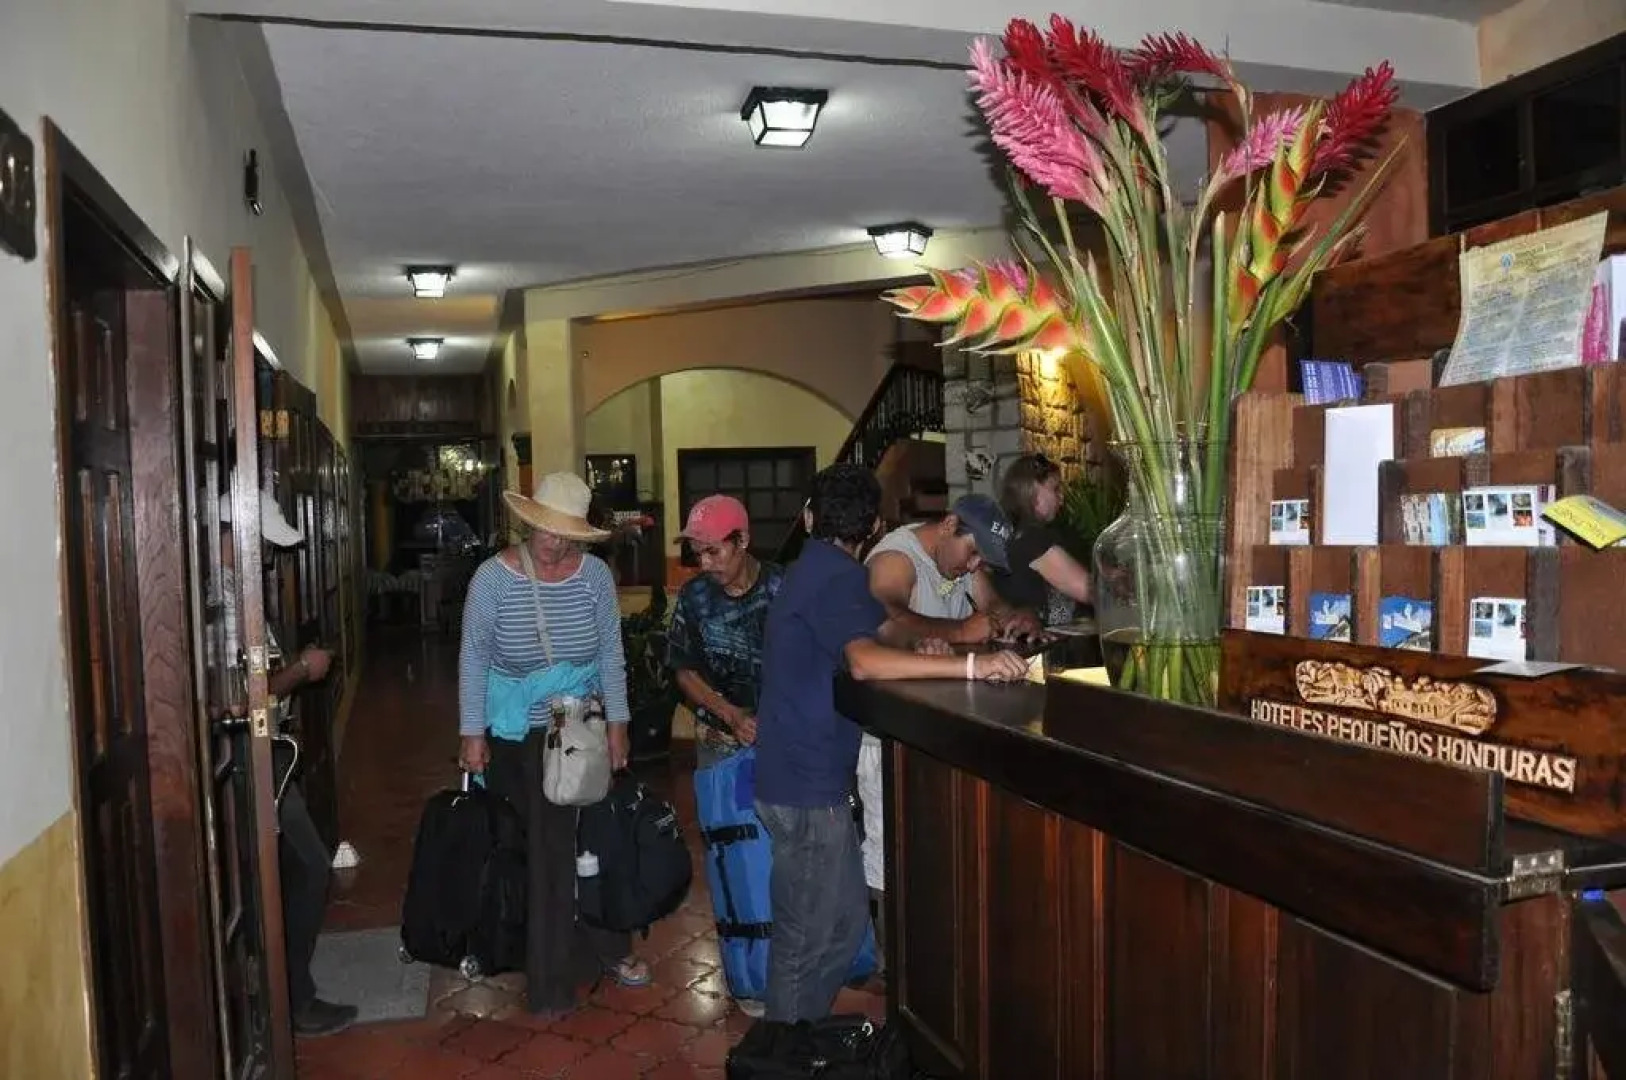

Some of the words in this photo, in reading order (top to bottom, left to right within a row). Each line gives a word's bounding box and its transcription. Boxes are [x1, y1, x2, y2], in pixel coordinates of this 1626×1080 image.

[1251, 699, 1324, 734] HOTELES
[1327, 713, 1433, 757] PEQUEÑOS
[1437, 735, 1574, 790] HONDURAS
